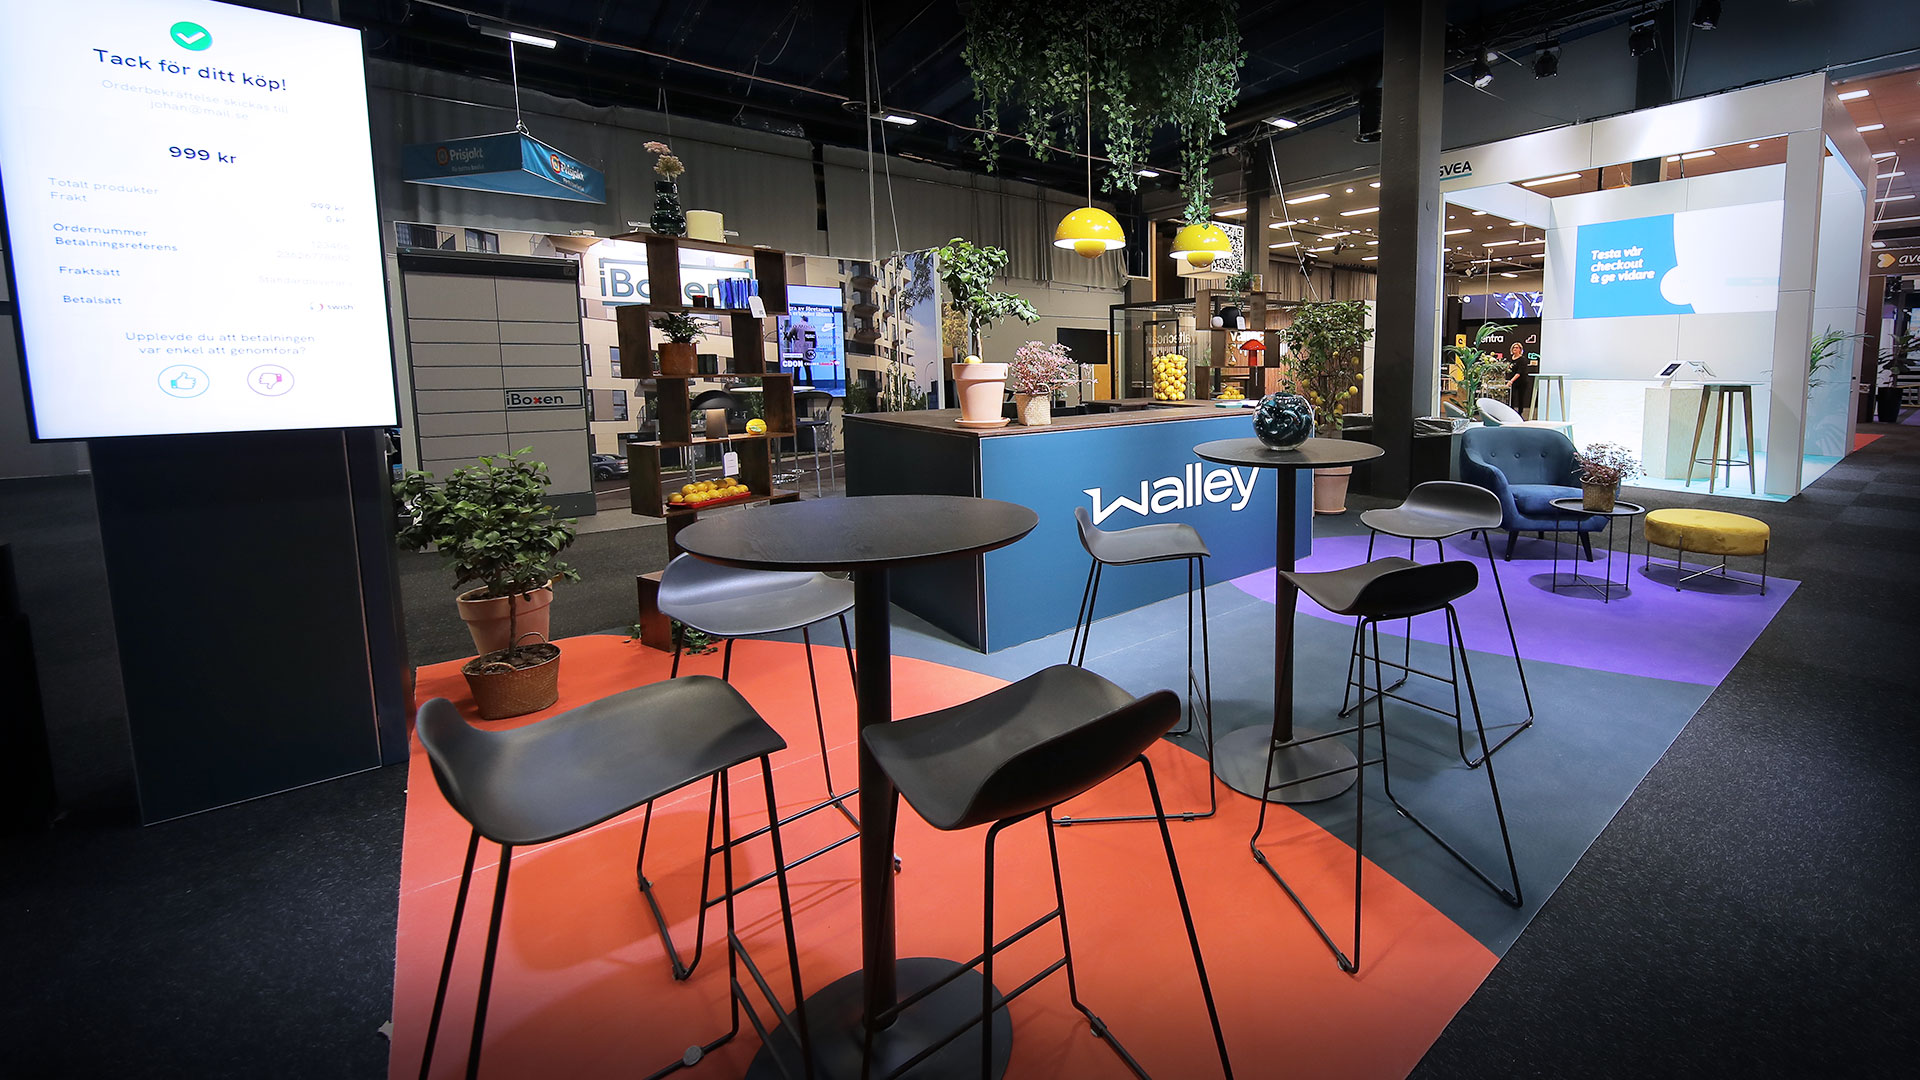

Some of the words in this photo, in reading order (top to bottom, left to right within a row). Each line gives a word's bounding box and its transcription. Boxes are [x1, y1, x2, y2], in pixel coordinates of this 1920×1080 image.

[93, 48, 152, 70] Tack
[158, 59, 191, 75] för
[198, 67, 236, 83] ditt
[242, 72, 287, 91] köp!
[224, 97, 270, 111] skickas
[273, 105, 289, 114] till
[168, 145, 211, 162] 999
[218, 151, 237, 164] kr
[449, 147, 483, 162] Prisjakt
[48, 177, 89, 189] Totalt
[93, 183, 159, 195] produkter
[50, 191, 87, 202] Frakt
[53, 223, 148, 236] Ordernummer
[55, 236, 178, 251] Betalningsreferens
[1590, 249, 1622, 260] Testa
[1623, 245, 1644, 257] vår
[1590, 258, 1644, 272] checkout
[1590, 273, 1601, 284] &
[1600, 273, 1617, 285] ge
[1617, 269, 1656, 281] vidare
[125, 332, 193, 342] Upplevde
[197, 333, 214, 341] du
[219, 334, 237, 342] att
[241, 334, 315, 344] betalningen
[166, 346, 204, 354] enkel
[208, 347, 226, 355] att
[506, 393, 564, 406] iBoxen
